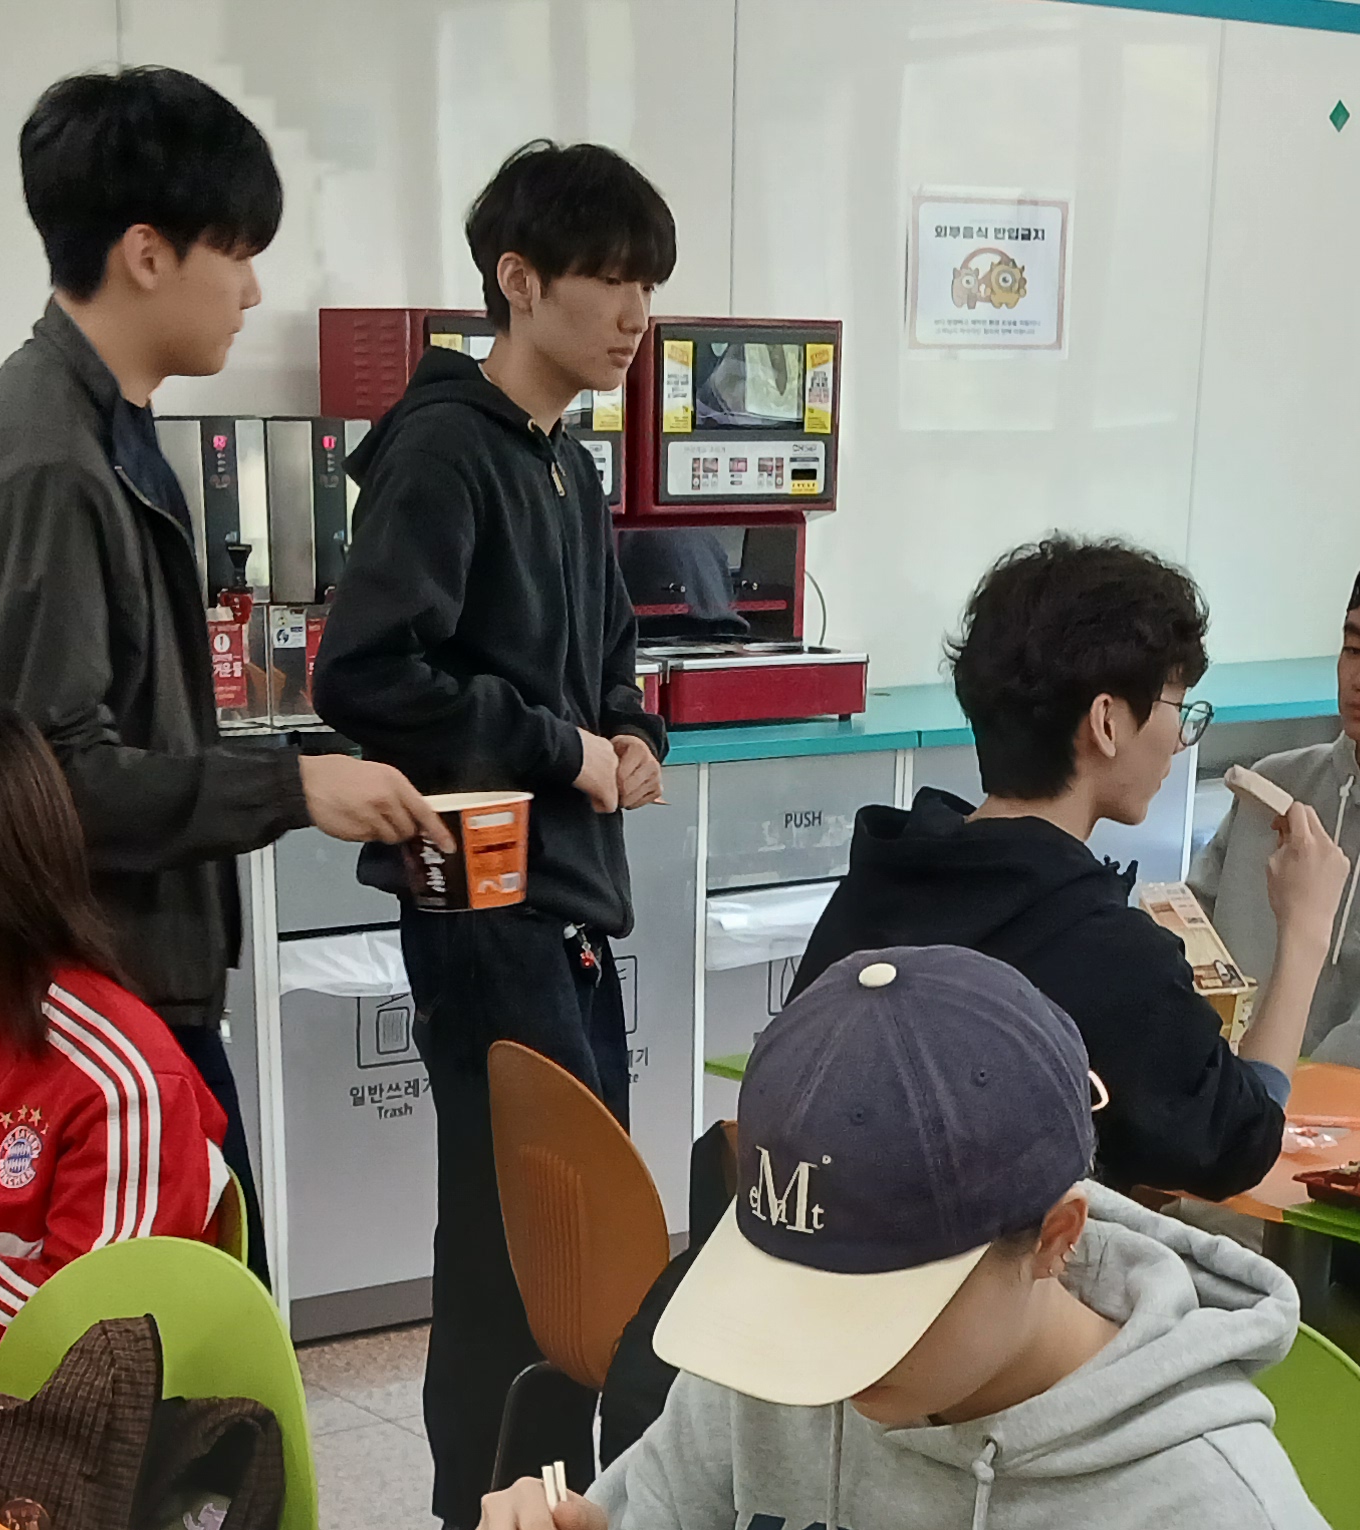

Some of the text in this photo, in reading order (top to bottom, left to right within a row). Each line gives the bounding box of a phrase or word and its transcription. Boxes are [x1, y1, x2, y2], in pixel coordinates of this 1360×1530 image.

[934, 225, 1045, 241] 외부음식 반입금지
[784, 810, 822, 829] PUSH
[377, 1102, 413, 1120] Trash
